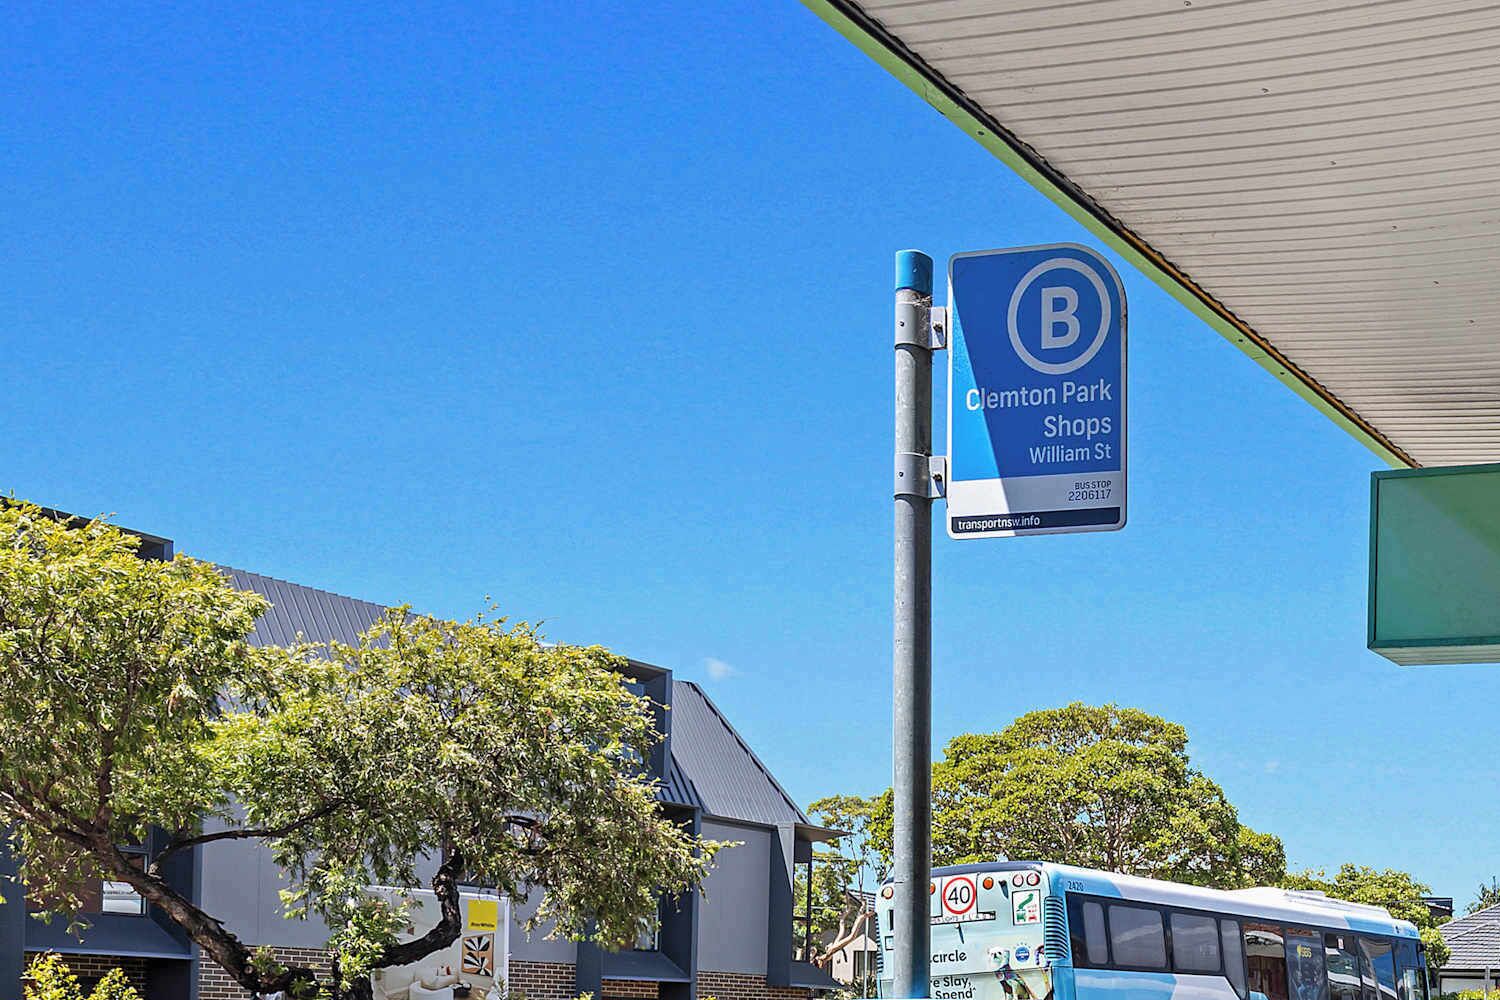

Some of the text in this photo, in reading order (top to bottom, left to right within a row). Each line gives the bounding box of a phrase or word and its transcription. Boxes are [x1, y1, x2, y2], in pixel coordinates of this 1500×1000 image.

[1041, 286, 1081, 350] B
[966, 379, 1112, 411] Clemton Park
[1044, 414, 1112, 440] Shops
[1030, 443, 1112, 464] William St
[1068, 489, 1112, 501] 2206117
[1075, 480, 1111, 490] BUS STOP
[958, 515, 1040, 531] transportnsw.info
[948, 885, 971, 905] 40
